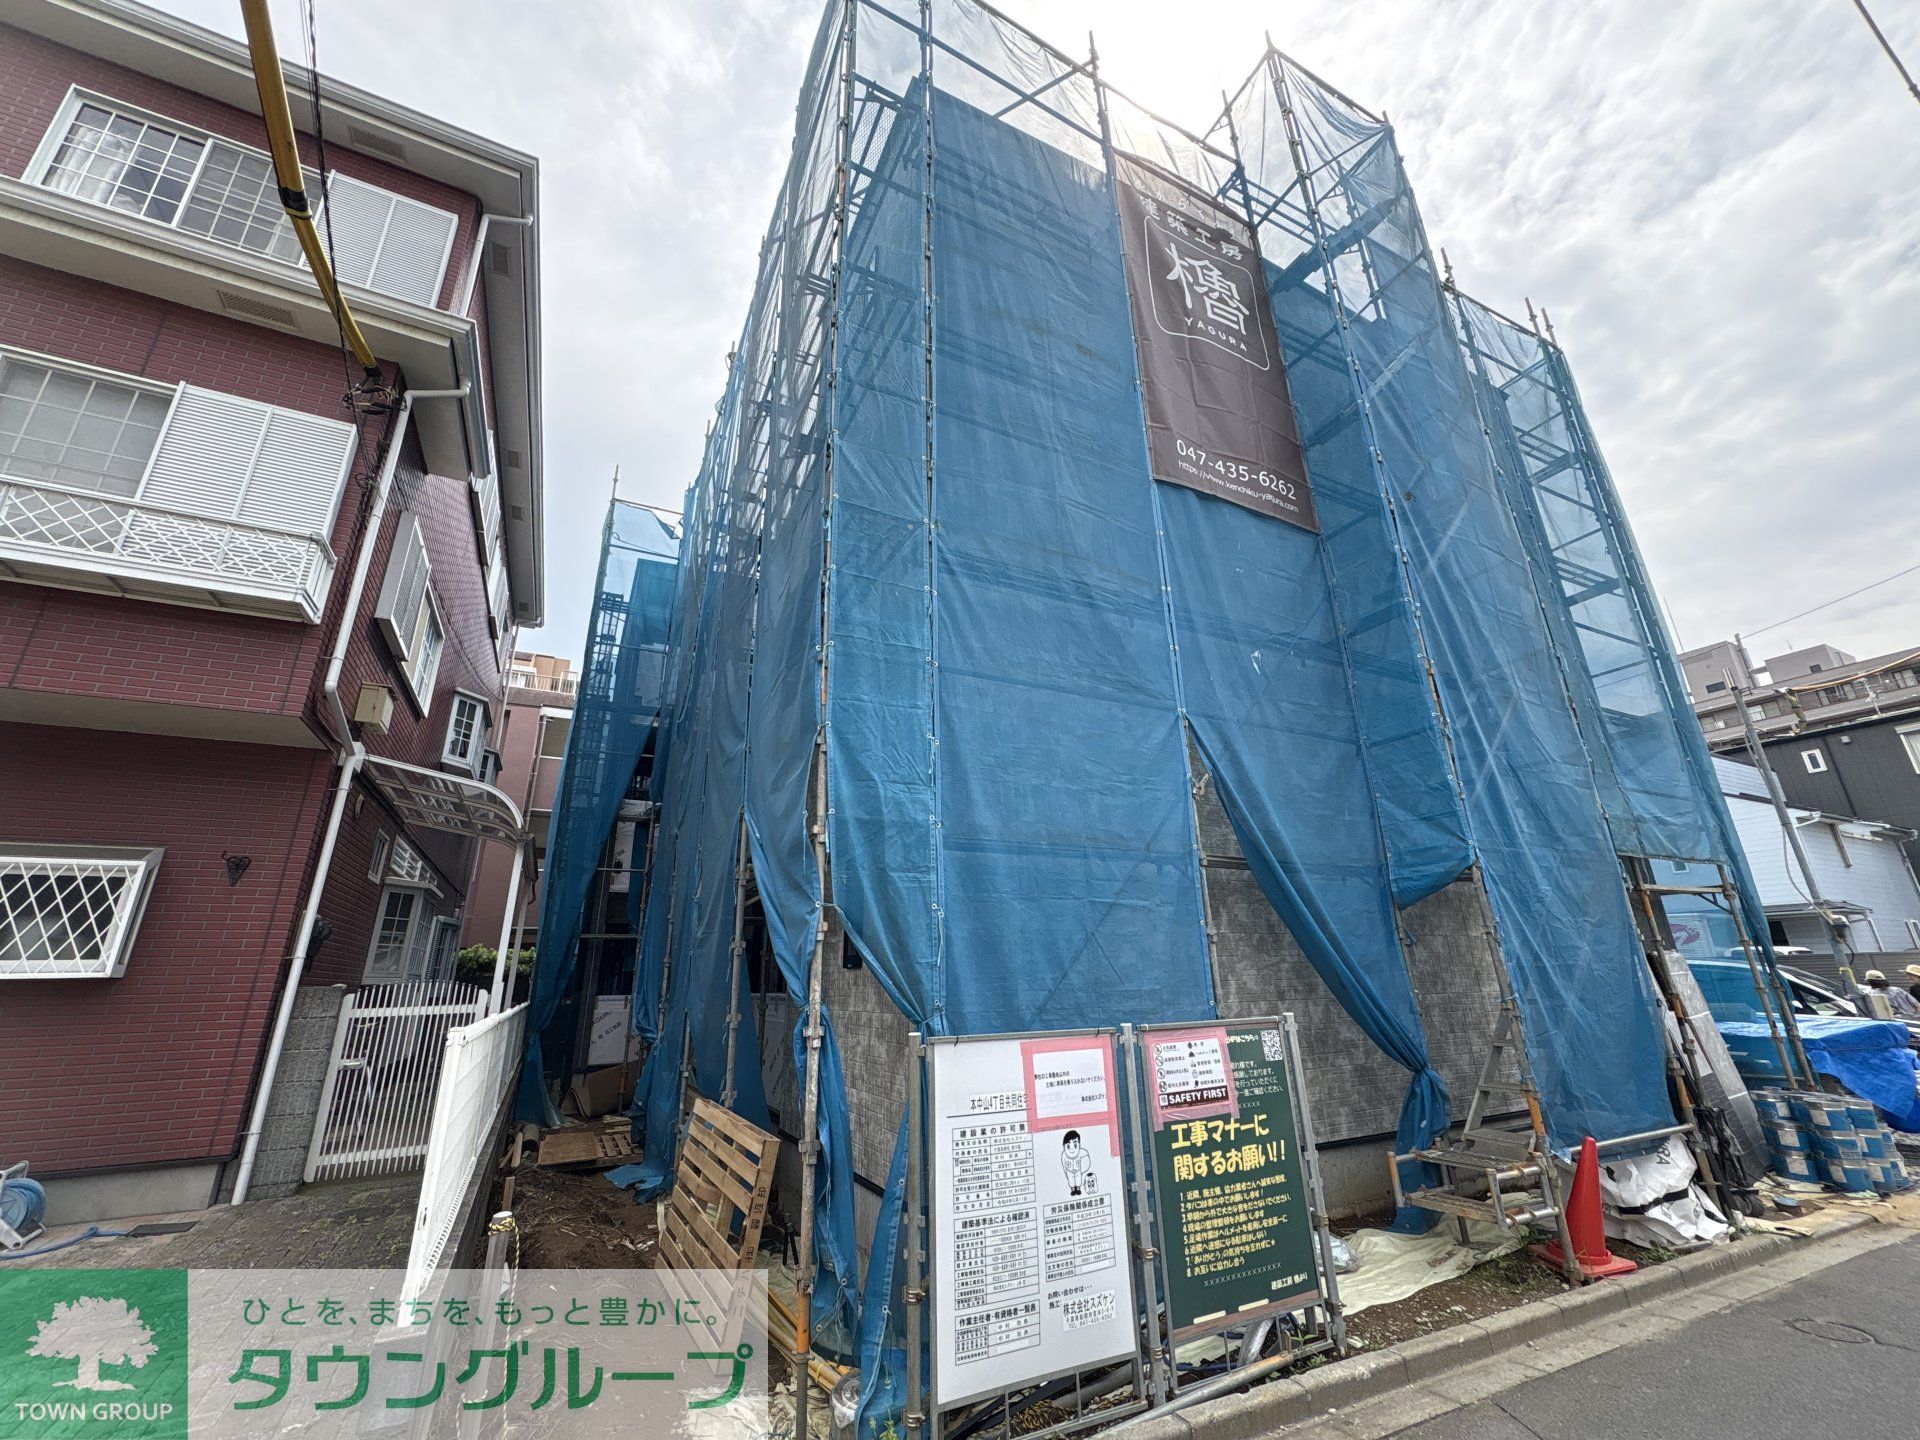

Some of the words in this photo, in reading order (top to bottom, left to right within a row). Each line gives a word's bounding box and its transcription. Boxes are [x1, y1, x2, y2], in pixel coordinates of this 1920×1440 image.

[1138, 192, 1243, 261] 建築工房
[1185, 317, 1248, 352] YAGURA
[1176, 439, 1297, 500] 047-435-6262
[1169, 1092, 1201, 1105] SAFETY
[1203, 1088, 1226, 1100] FIRST
[1171, 1114, 1270, 1150] 工事マナーに
[1174, 1139, 1286, 1182] 関するお願い!!
[962, 1211, 1030, 1229] 建築基準法による確認済
[1063, 1292, 1115, 1317] 株式会社スズケン
